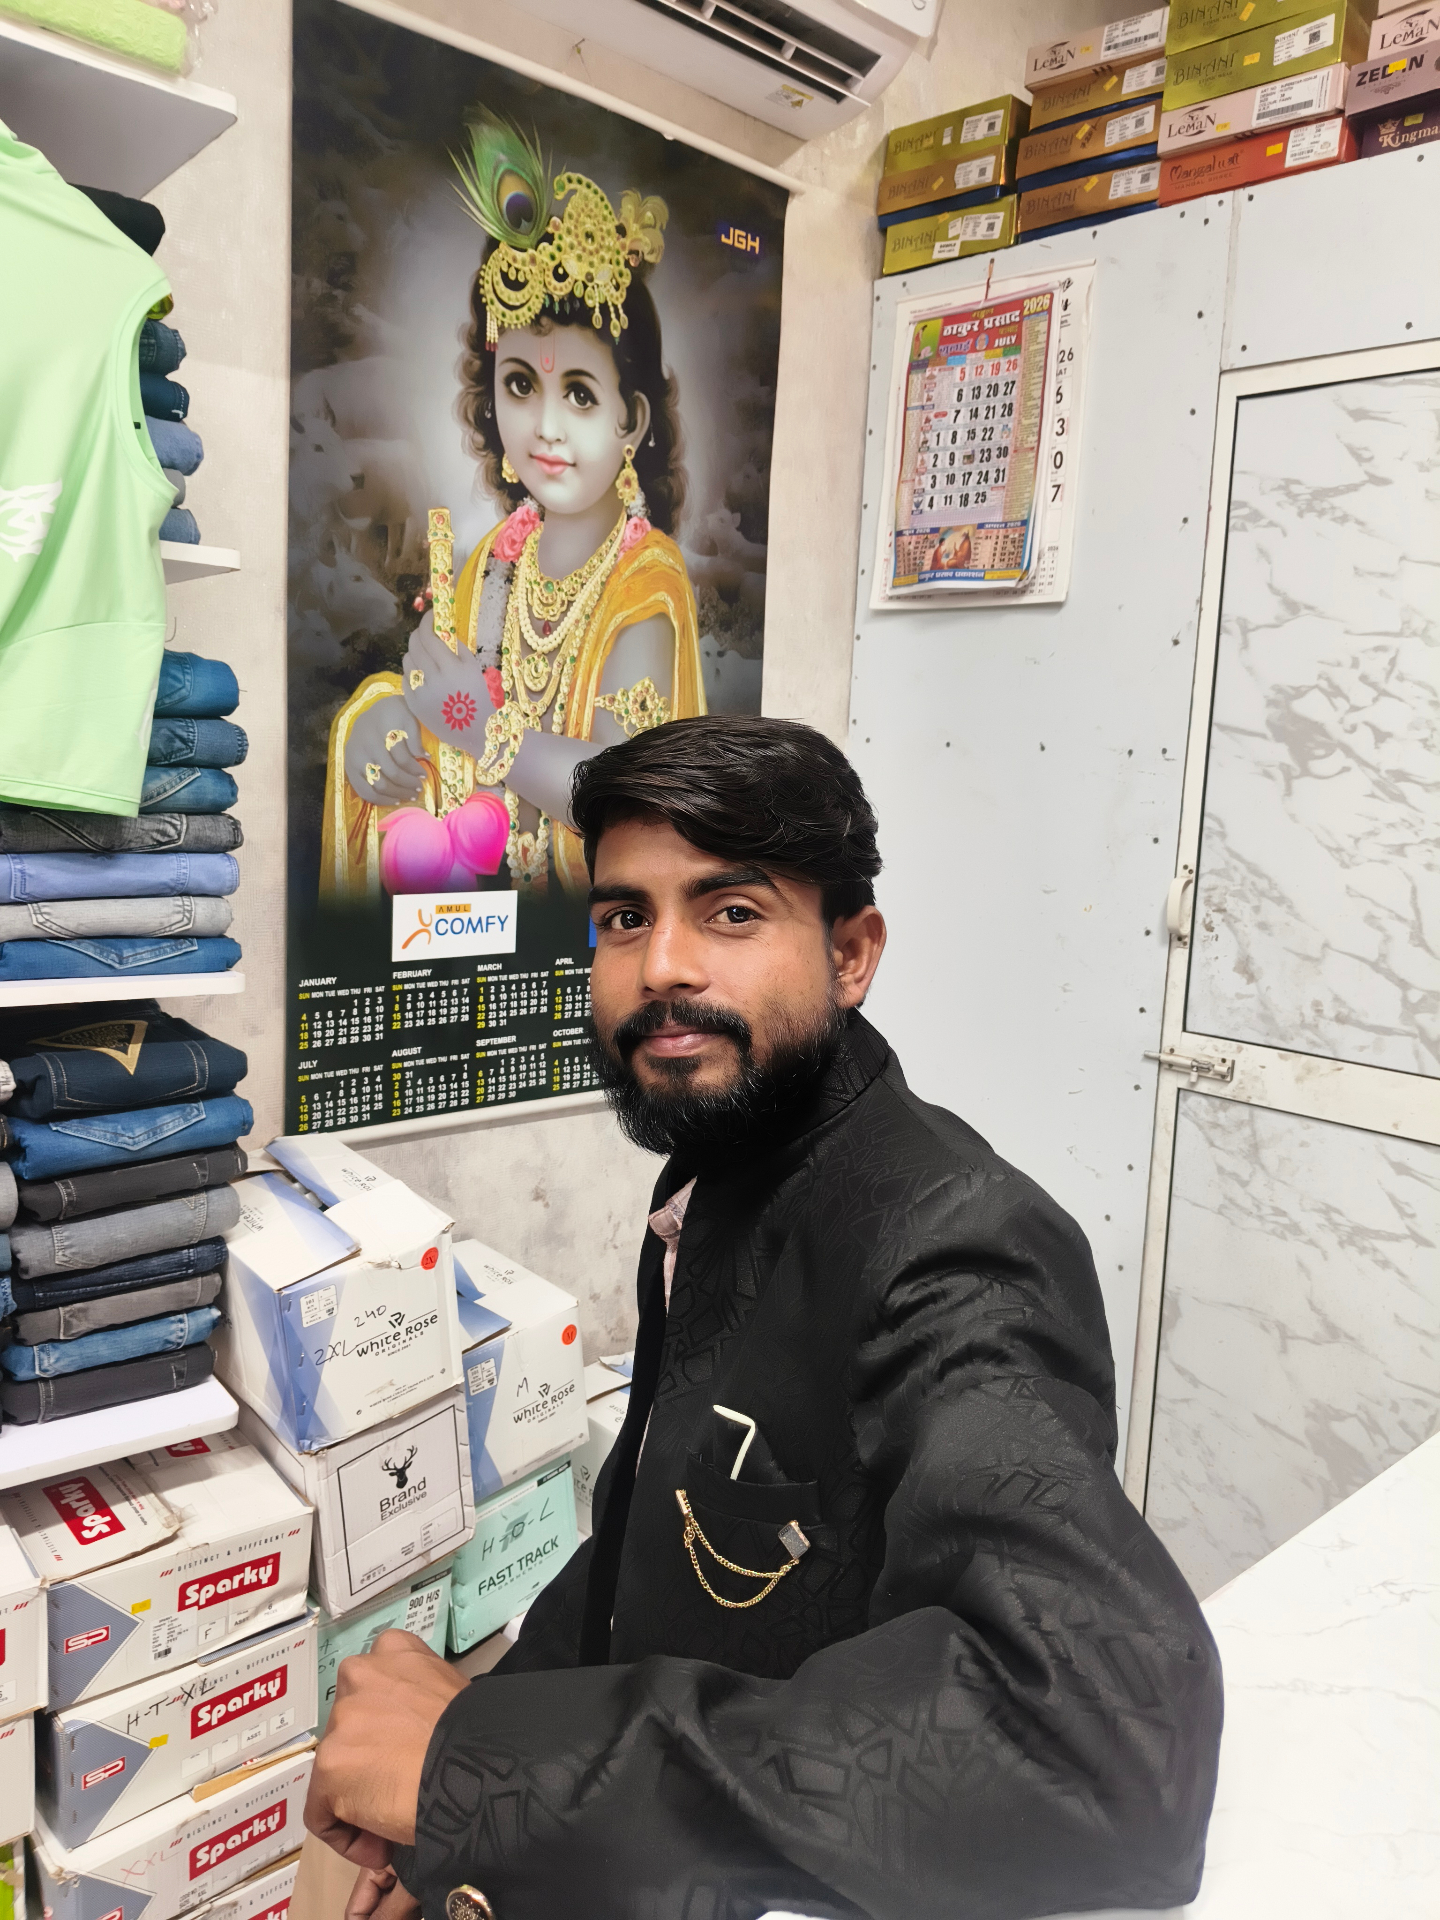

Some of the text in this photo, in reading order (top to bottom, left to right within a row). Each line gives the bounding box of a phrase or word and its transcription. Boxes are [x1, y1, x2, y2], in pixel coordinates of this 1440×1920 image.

[1173, 52, 1236, 86] BINANI
[1356, 54, 1424, 87] ZEDN
[1378, 125, 1440, 148] Kingma
[721, 226, 760, 254] JGH
[994, 334, 1016, 348] JULY
[1058, 347, 1074, 364] 26
[959, 358, 1018, 382] 5 12 19 26
[957, 380, 1016, 402] 6 13 20 27
[953, 402, 1013, 423] 7 14 21 28
[936, 427, 994, 446] 1 8 15 22
[1056, 418, 1065, 436] 3
[932, 446, 1008, 468] 2 9 23 30
[1054, 450, 1064, 470] 0
[930, 468, 1006, 489] 3 10 17 24 31
[928, 491, 986, 509] 4 11 18 25
[1051, 484, 1061, 502] 7
[438, 905, 468, 913] AMUL
[434, 915, 509, 935] COMFY
[393, 969, 432, 979] FEBRUARY
[477, 963, 502, 971] MARCH
[299, 977, 337, 988] JANUARY
[375, 985, 385, 993] SAT
[377, 996, 382, 1004] 3
[301, 1013, 307, 1021] 4
[315, 1011, 320, 1020] 5
[327, 1010, 333, 1018] 6
[340, 1009, 346, 1017] 7
[352, 1008, 358, 1016] 8
[375, 1005, 384, 1013] 10
[313, 1021, 322, 1029] 12
[325, 1020, 335, 1028] 13
[338, 1018, 348, 1026] 14
[350, 1017, 360, 1025] 15
[375, 1014, 384, 1022] 17
[299, 1032, 383, 1050] 25 26 27 28 29 30 31
[300, 1023, 384, 1040] 18 19 20 21 22 23 24
[476, 1035, 516, 1046] SEPTEMBER
[553, 1027, 584, 1037] OCTOBER
[392, 1046, 422, 1057] AUGUST
[298, 1060, 318, 1069] JULY
[354, 1305, 386, 1327] 240
[314, 1340, 358, 1366] 2XL
[375, 1331, 424, 1356] ORIGINALS
[516, 1377, 529, 1397] M
[527, 1401, 564, 1423] ORIGINALS
[380, 1477, 426, 1513] Brand
[57, 1482, 112, 1539] Sparky
[380, 1491, 427, 1521] Exclusive
[178, 1554, 220, 1572] DISTINCT
[238, 1533, 285, 1552] DIFFERENT
[478, 1563, 514, 1596] FAST
[517, 1535, 559, 1570] TRACK
[498, 1559, 543, 1591] GARMENTS
[185, 1564, 273, 1606] Sparky
[409, 1589, 440, 1610] 900 H/S
[405, 1621, 416, 1629] QTY
[67, 1628, 108, 1652] SP
[246, 1646, 290, 1670] DIFFERENT
[198, 1678, 281, 1727] Sparky
[85, 1760, 124, 1787] SP
[186, 1813, 227, 1839] DISTINCT
[246, 1781, 290, 1808] DIFFERENT
[196, 1810, 280, 1868] Sparky
[260, 1876, 296, 1899] DIFFERE
